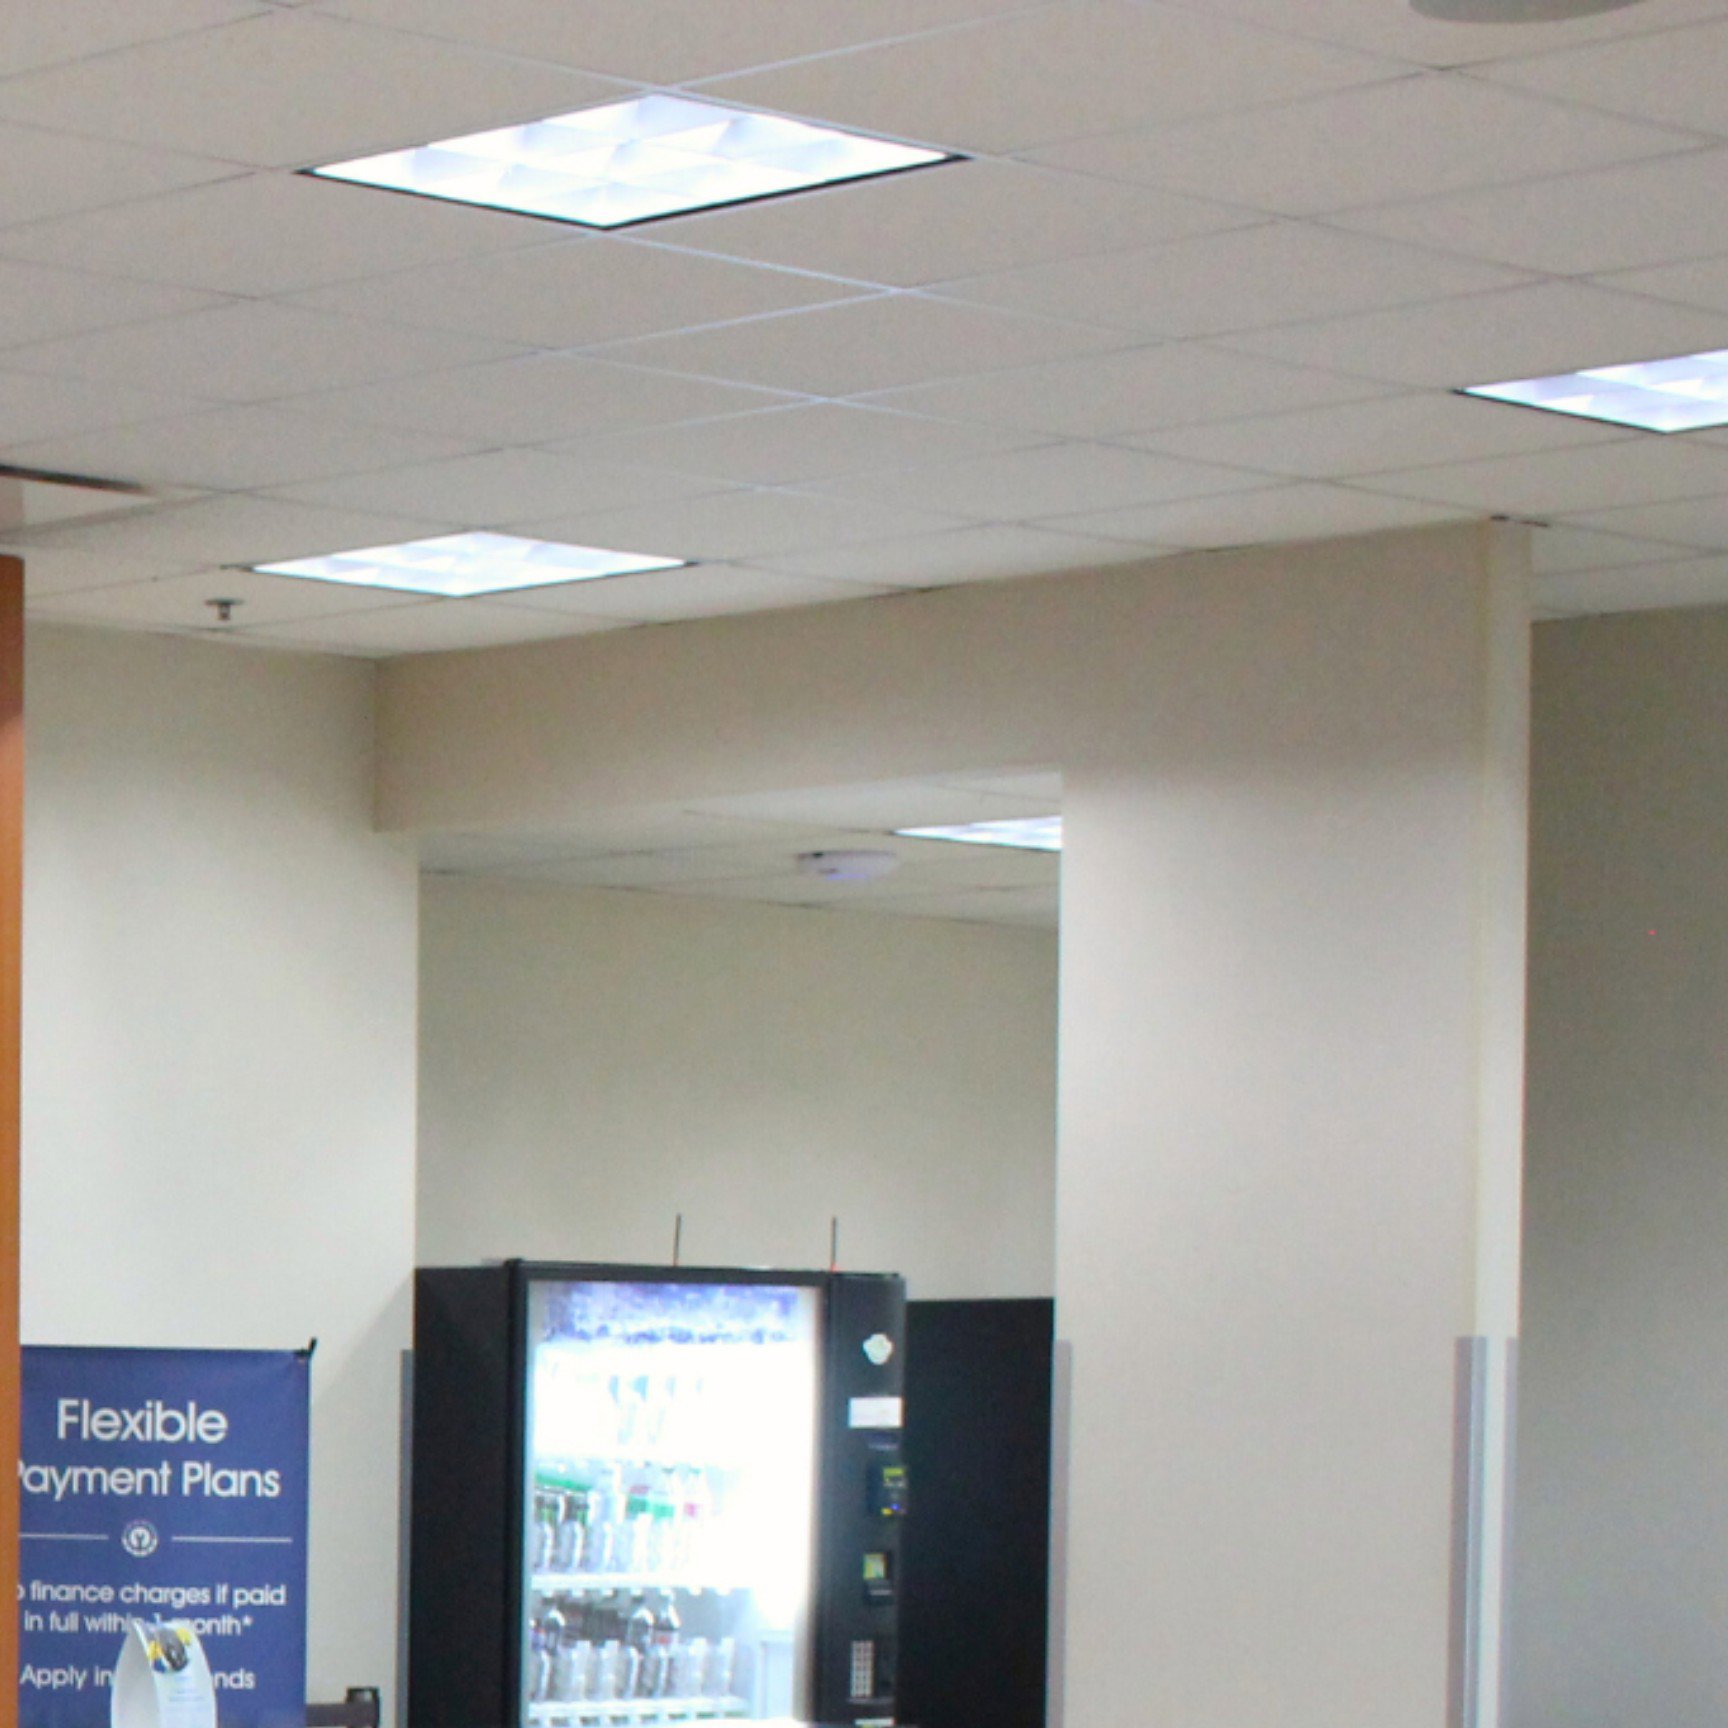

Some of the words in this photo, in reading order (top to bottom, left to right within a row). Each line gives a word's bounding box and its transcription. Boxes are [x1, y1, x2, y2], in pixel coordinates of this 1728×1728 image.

[57, 1398, 228, 1444] Flexible
[182, 1459, 281, 1498] Plans
[30, 1580, 114, 1602] finance
[119, 1582, 210, 1608] charges
[216, 1582, 231, 1604] if
[232, 1583, 288, 1609] paid
[24, 1610, 43, 1631] in
[49, 1611, 79, 1632] full
[180, 1614, 253, 1636] onth
[19, 1664, 88, 1690] Apply
